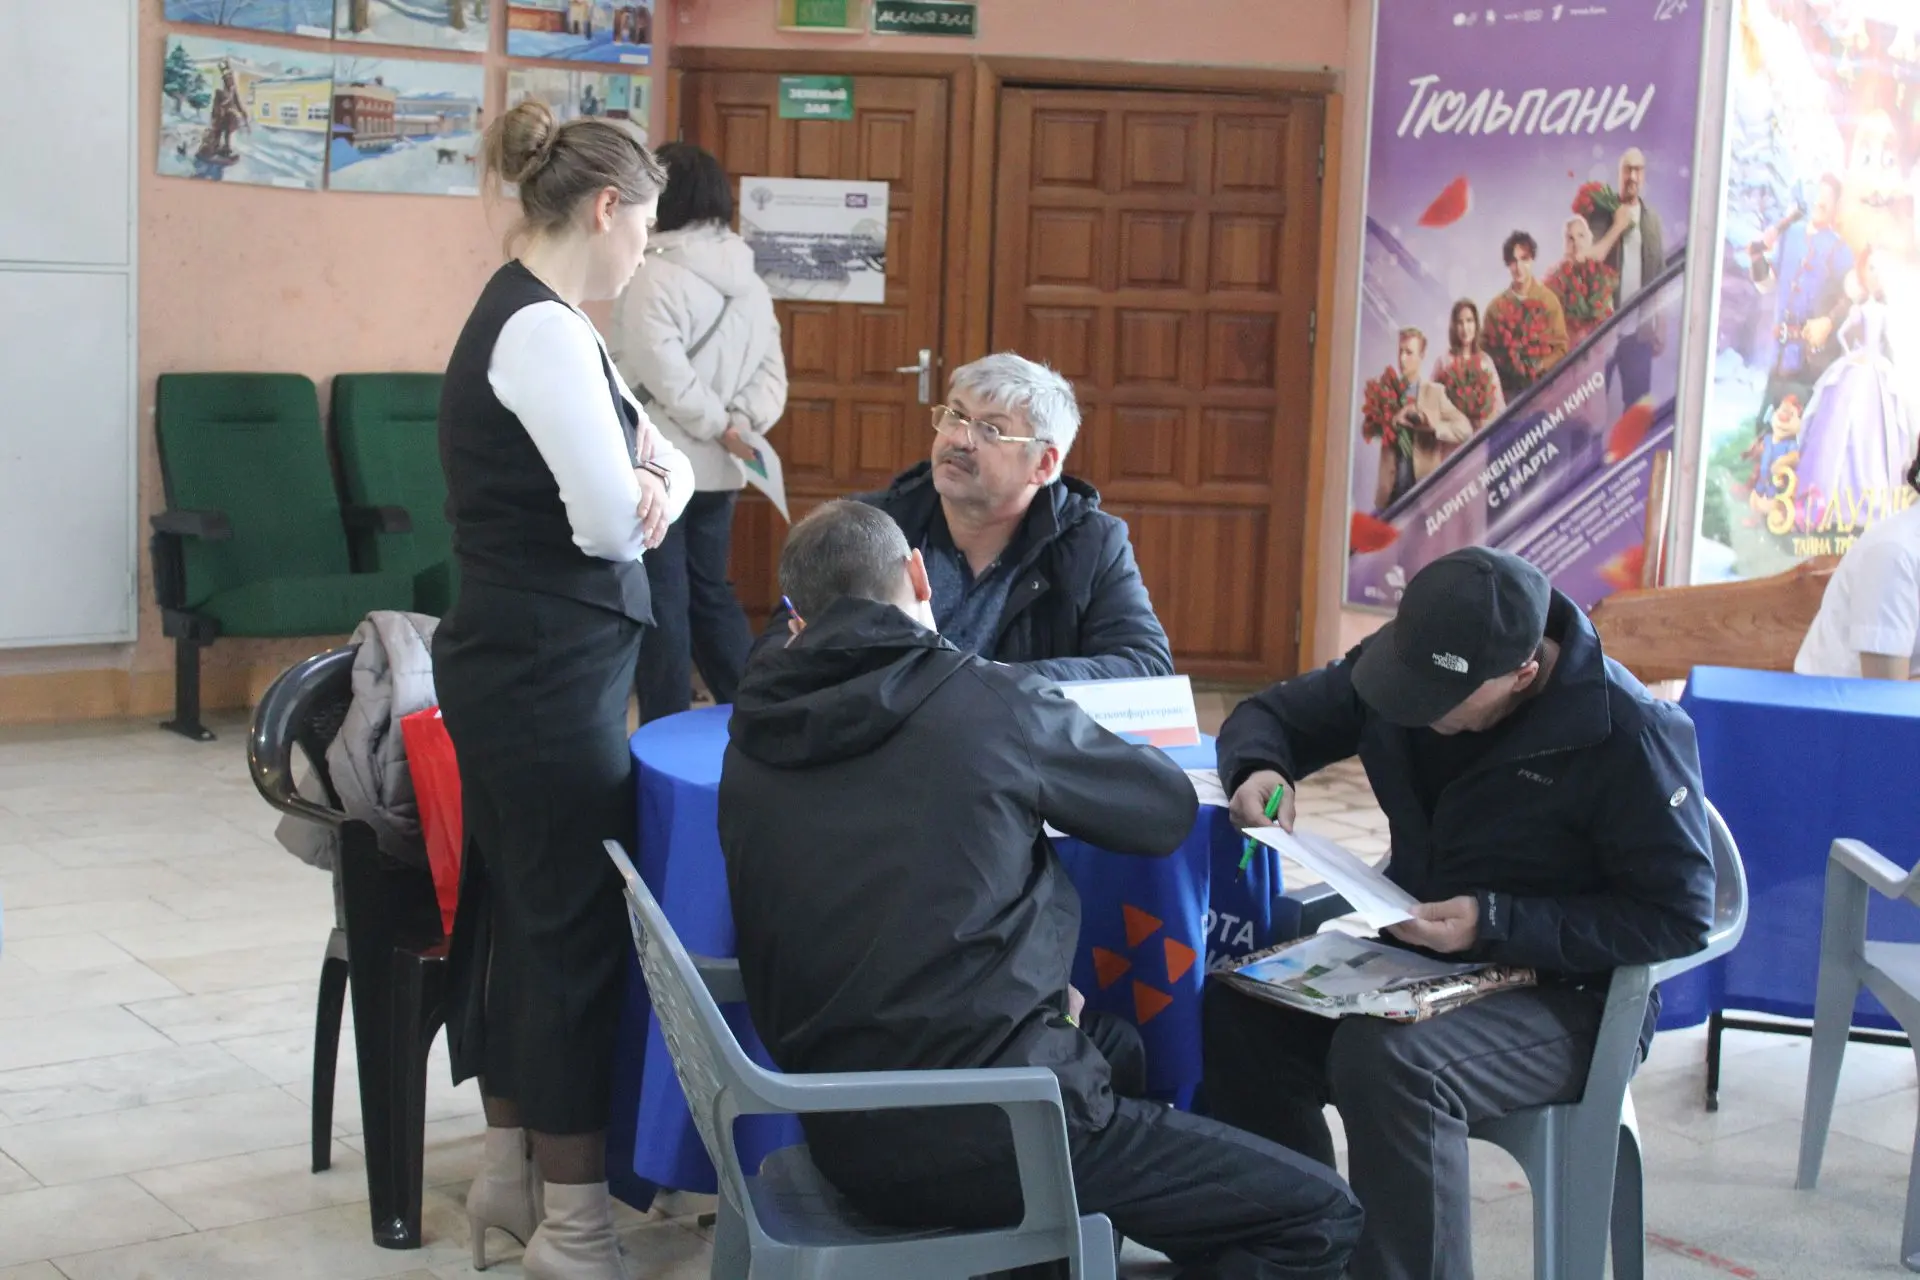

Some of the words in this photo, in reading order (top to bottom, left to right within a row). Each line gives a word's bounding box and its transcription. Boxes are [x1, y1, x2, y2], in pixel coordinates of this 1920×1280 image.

[1425, 480, 1479, 536] ДАРИТЕ
[1477, 406, 1565, 490] ЖЕНЩИНАМ
[1563, 371, 1604, 415] КИНО
[1488, 490, 1500, 508] С
[1508, 442, 1560, 491] МАРТА
